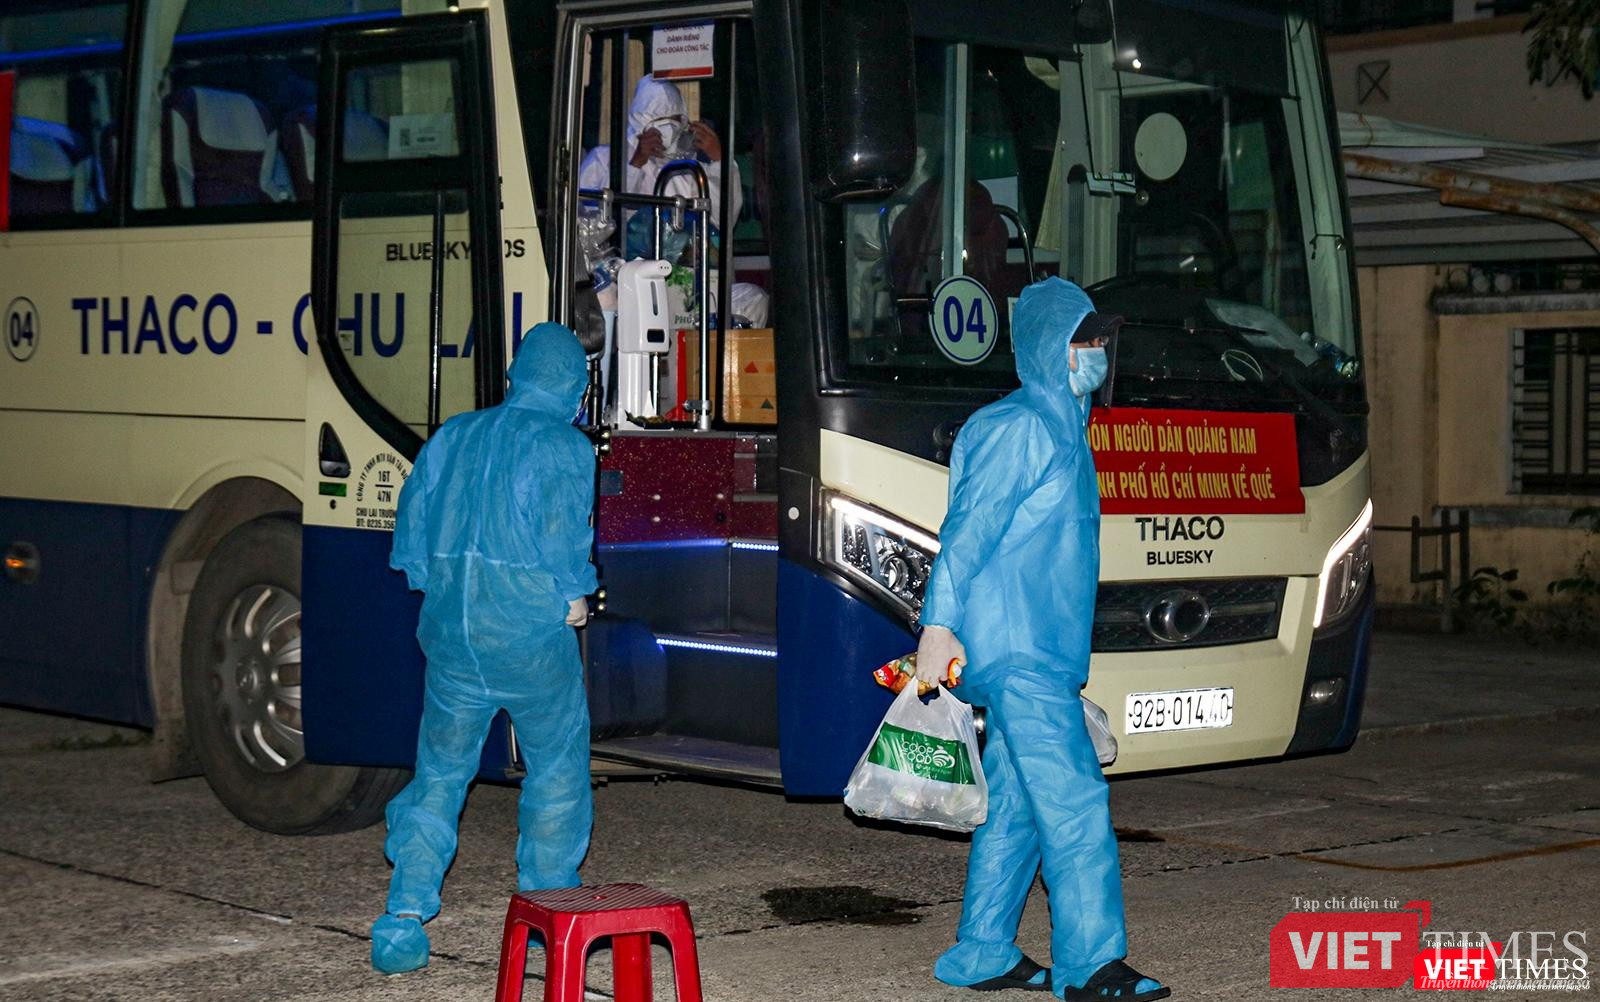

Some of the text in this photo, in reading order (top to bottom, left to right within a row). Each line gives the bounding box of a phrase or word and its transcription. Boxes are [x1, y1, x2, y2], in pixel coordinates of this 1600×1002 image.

[386, 241, 472, 262] BLUEKY
[9, 310, 34, 346] 04
[71, 292, 238, 356] THACO
[943, 295, 987, 344] 04
[1113, 417, 1155, 453] NGƯỜI
[1157, 418, 1184, 453] DÂN
[1186, 418, 1228, 456] QUẢNG
[1229, 427, 1257, 454] NAM
[1119, 461, 1149, 499] PHỐ
[1150, 461, 1170, 499] HỒ
[1171, 465, 1196, 499] CHÍ
[1197, 472, 1231, 499] MINH
[1231, 463, 1250, 499] VỀ
[1250, 466, 1276, 502] QUÊ
[1135, 516, 1225, 541] THACO
[1147, 549, 1213, 565] BLUESKY
